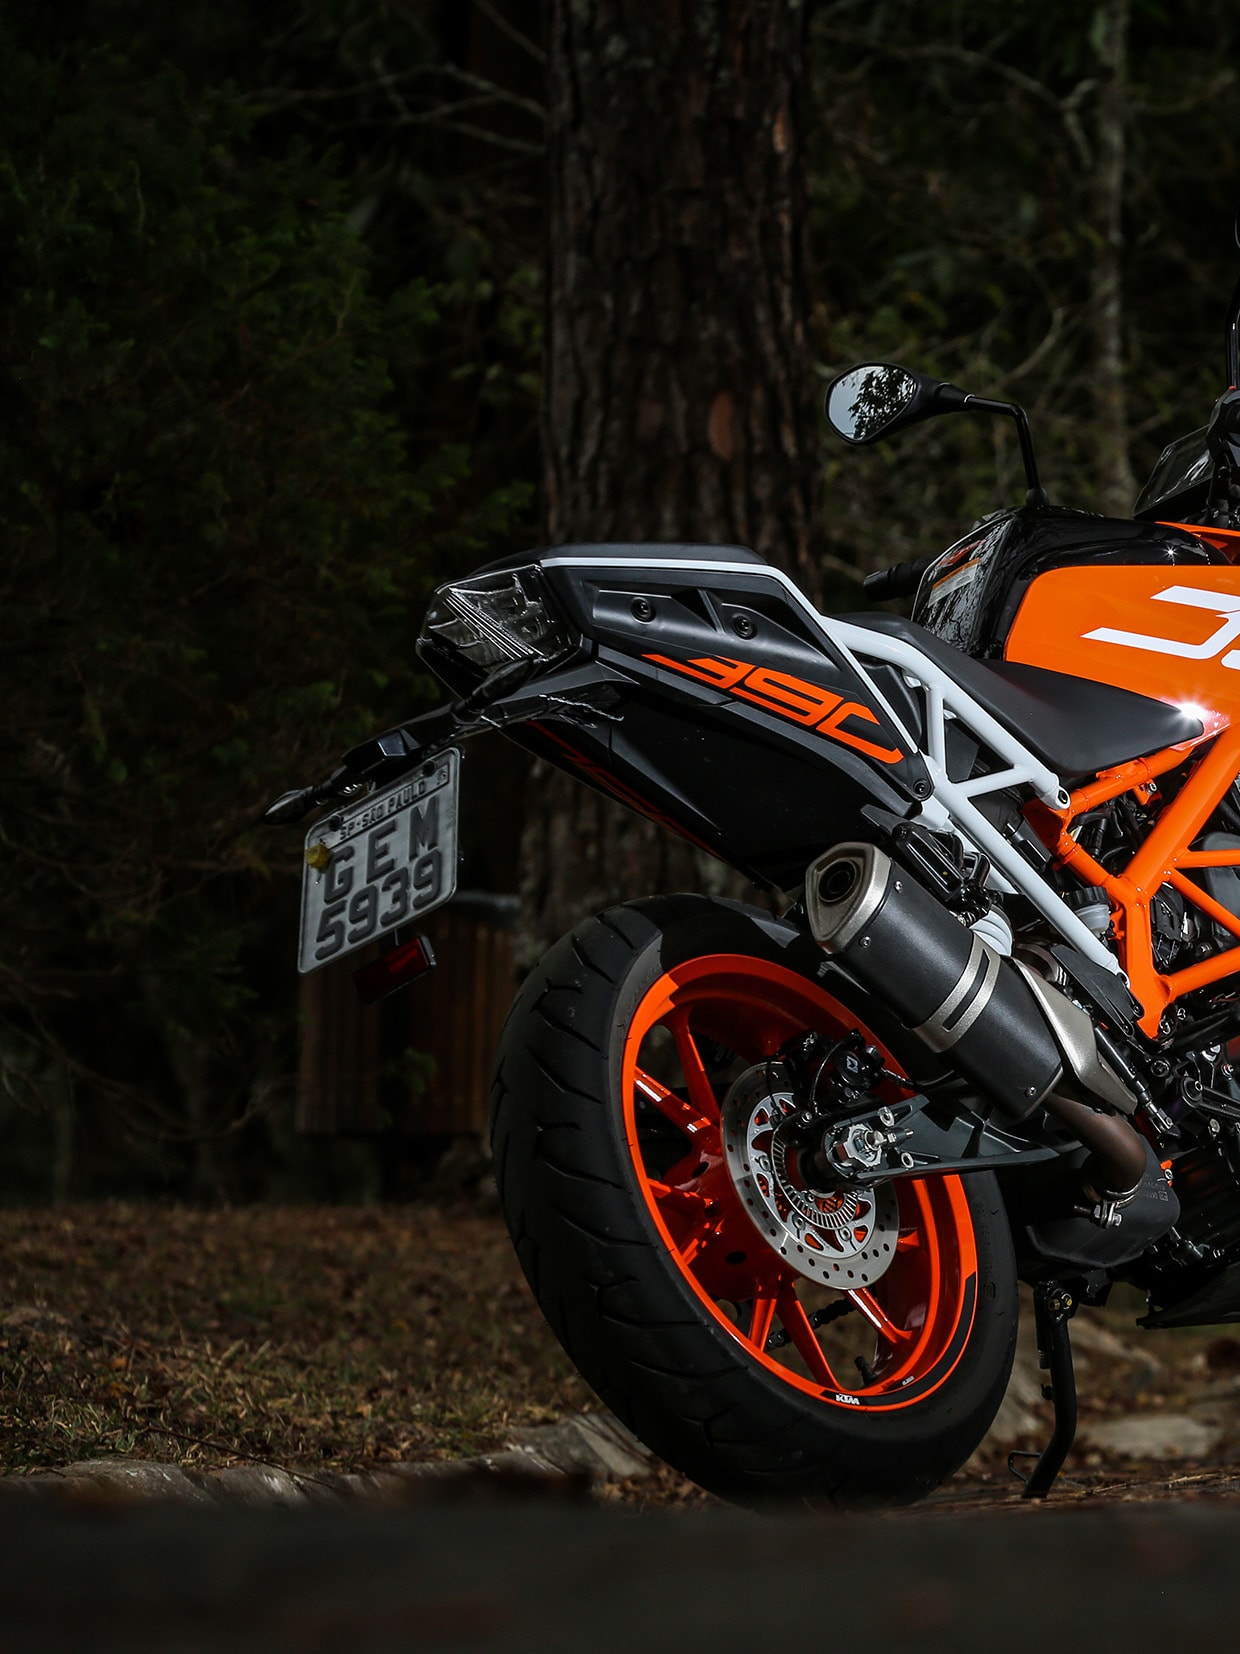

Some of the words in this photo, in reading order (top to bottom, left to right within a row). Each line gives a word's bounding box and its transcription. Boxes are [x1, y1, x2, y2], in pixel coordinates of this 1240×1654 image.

[640, 653, 905, 764] 390
[324, 795, 439, 905] GEM
[388, 780, 426, 814] PAULO
[314, 849, 443, 961] 5939
[835, 1393, 860, 1405] KTM
